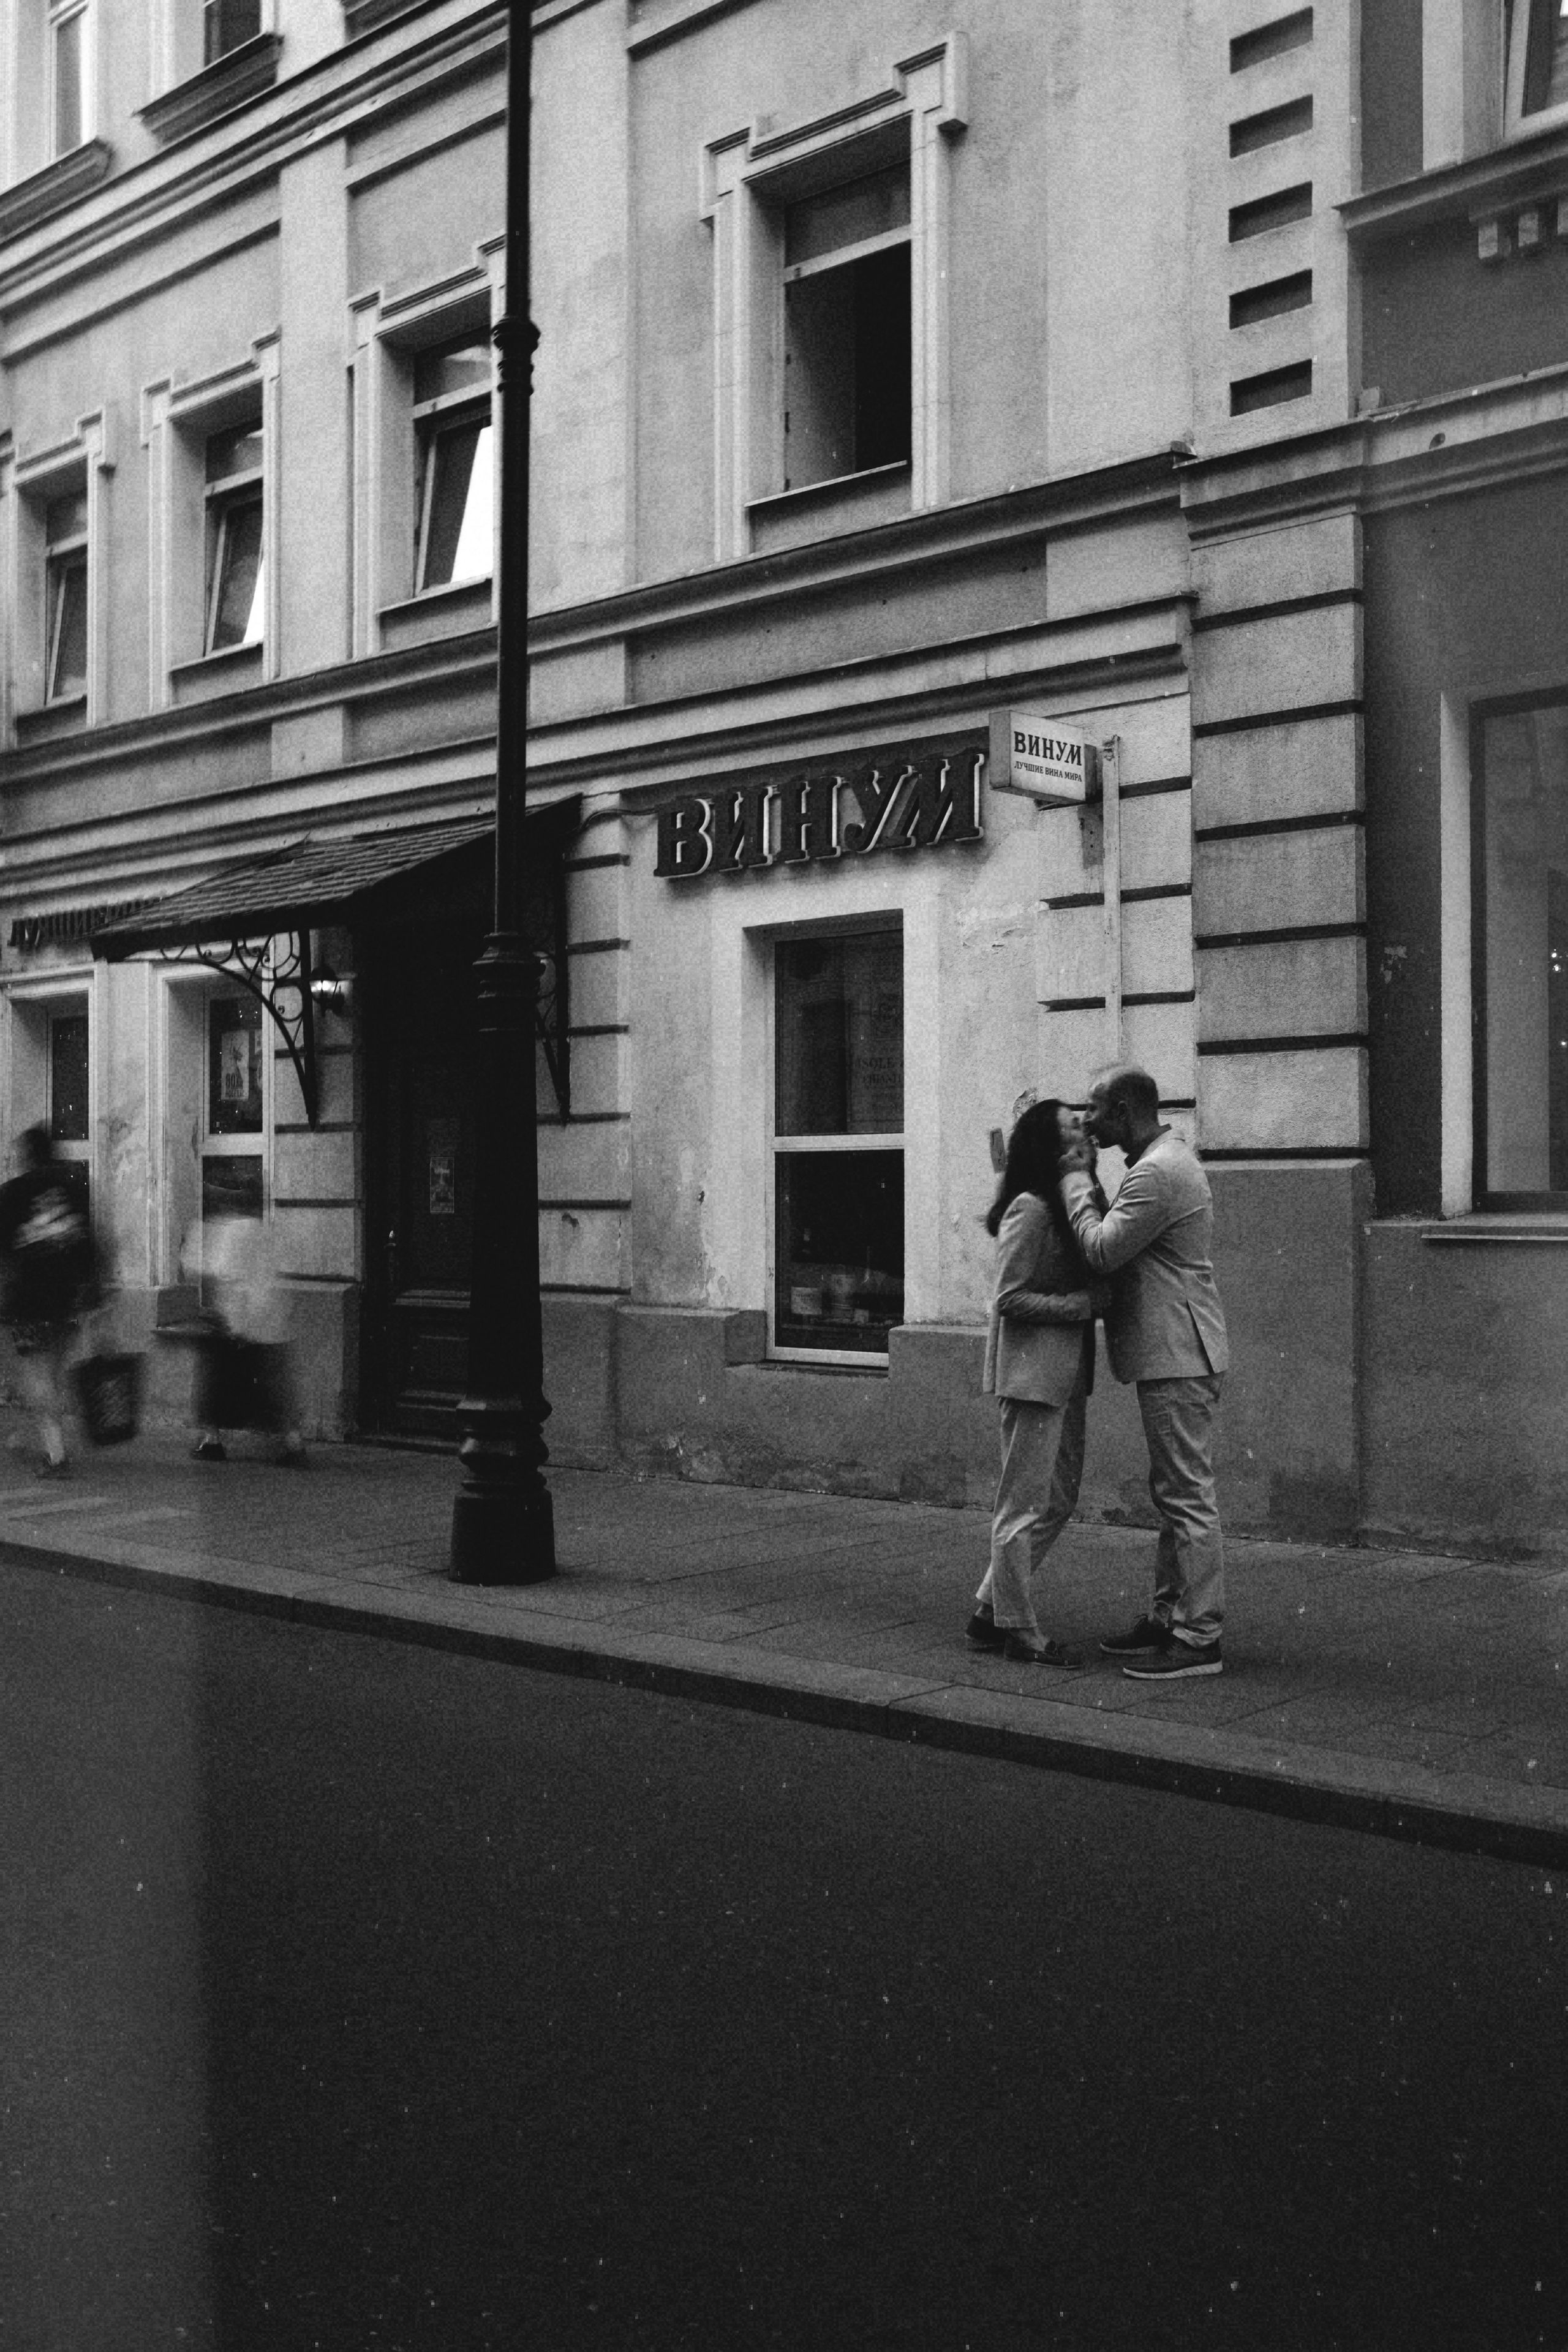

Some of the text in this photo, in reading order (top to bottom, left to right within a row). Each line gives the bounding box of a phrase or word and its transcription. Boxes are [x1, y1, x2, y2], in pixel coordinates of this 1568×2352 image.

[1014, 731, 1082, 766] ВИНУМ
[1014, 761, 1082, 782] ЛУЧШИЕ ВИНА МИРА
[654, 753, 984, 877] ВИНУМ
